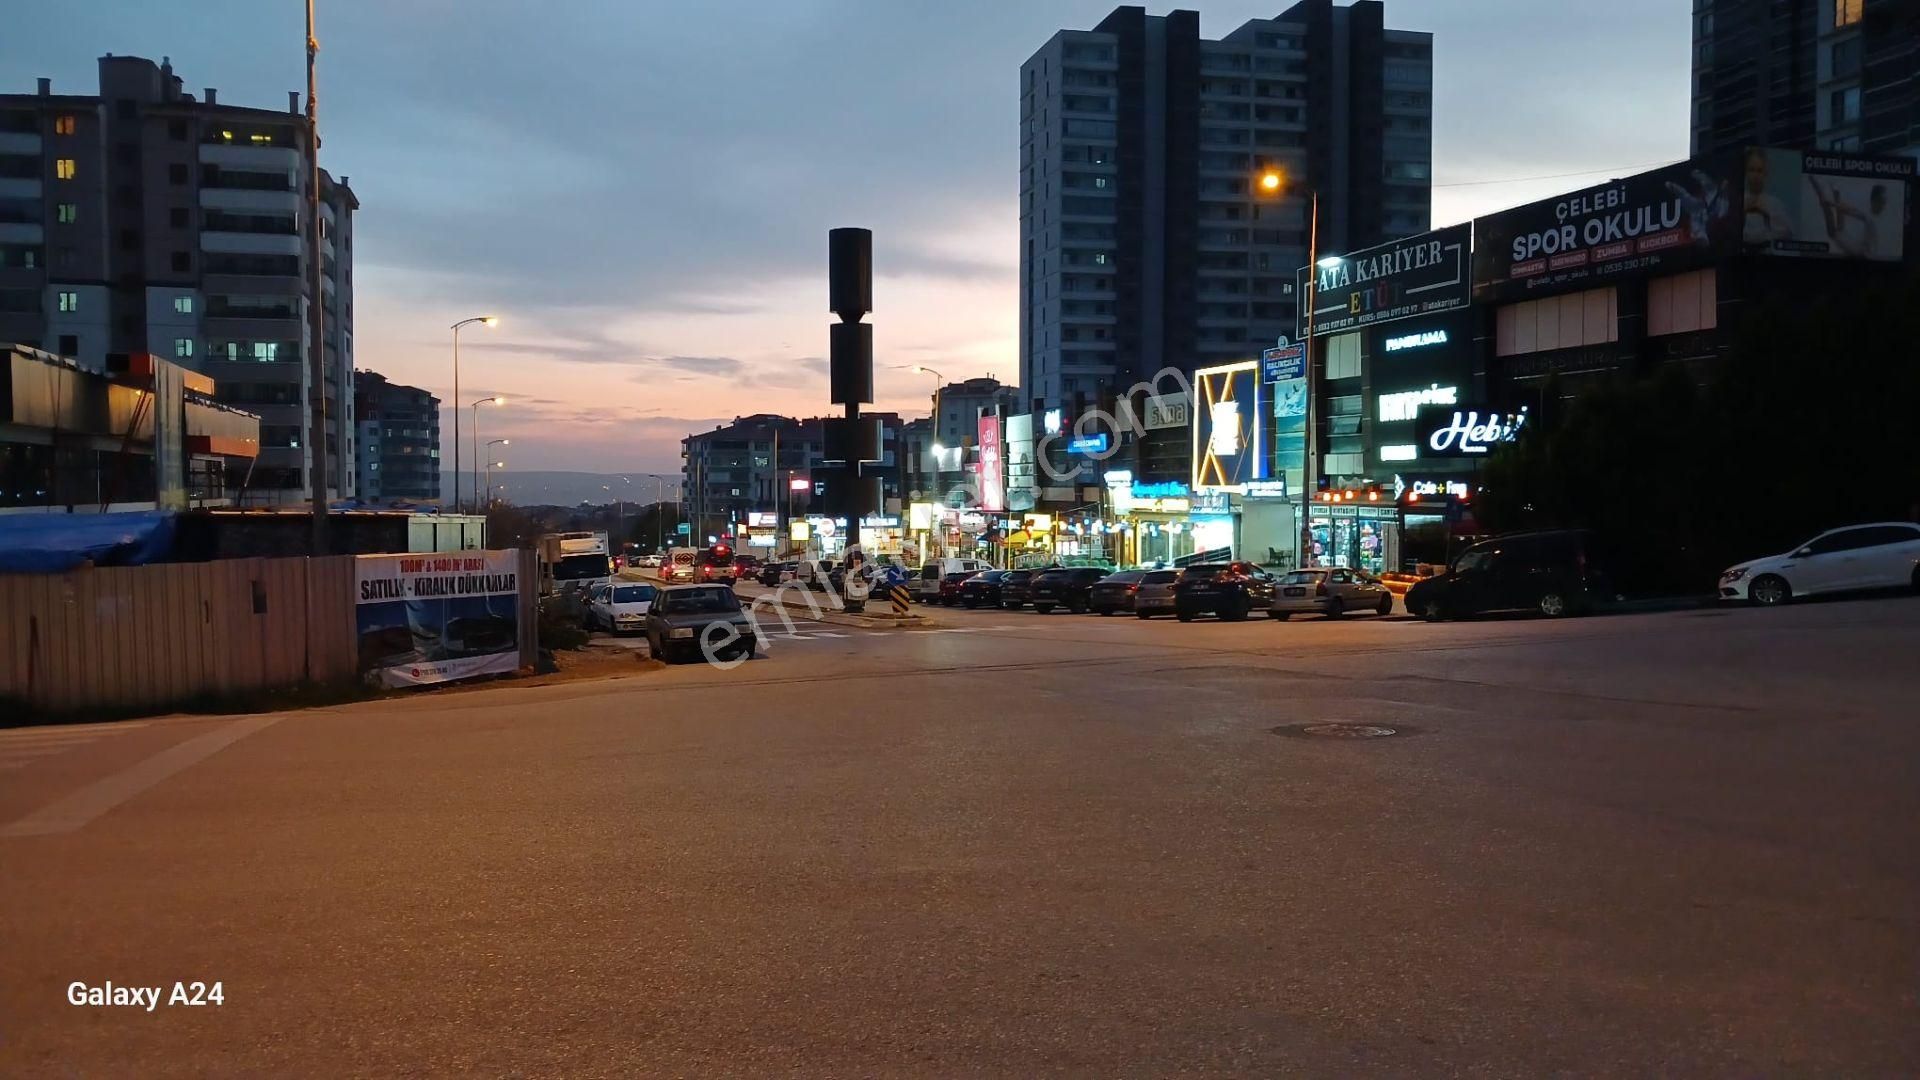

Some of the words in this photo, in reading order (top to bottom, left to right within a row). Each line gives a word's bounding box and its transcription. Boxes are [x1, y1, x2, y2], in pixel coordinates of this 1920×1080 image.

[1845, 159, 1872, 171] SPOR
[1512, 225, 1577, 262] SPOR
[1583, 198, 1682, 246] OKULU
[1596, 245, 1627, 258] ZUMBA
[1639, 234, 1680, 249] KICKBOX
[1318, 265, 1351, 293] ATA
[1355, 240, 1443, 284] KARİYER
[361, 577, 406, 601] SATILIK
[457, 573, 516, 595] DÜKKANLAR
